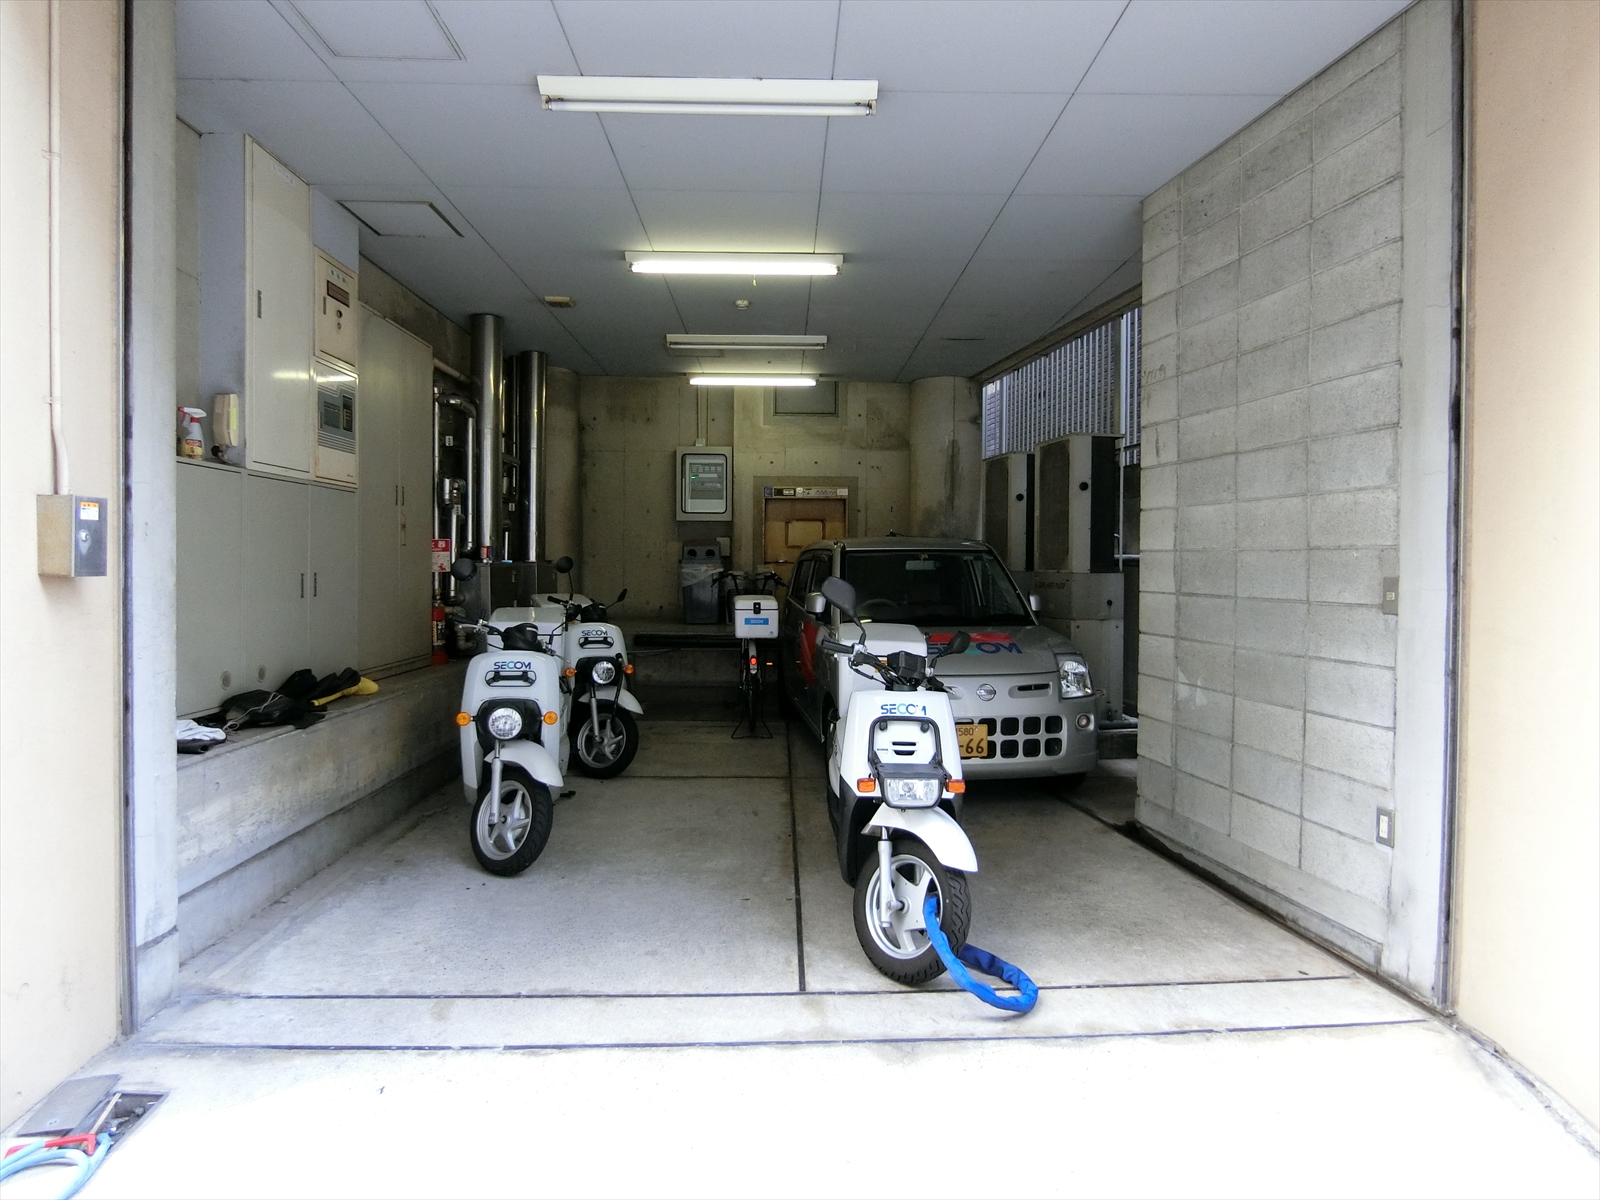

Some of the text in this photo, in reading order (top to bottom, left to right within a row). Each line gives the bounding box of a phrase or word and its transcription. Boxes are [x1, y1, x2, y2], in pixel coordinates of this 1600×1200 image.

[581, 629, 609, 637] SECOM
[493, 661, 532, 670] SECOM
[958, 727, 974, 736] 580
